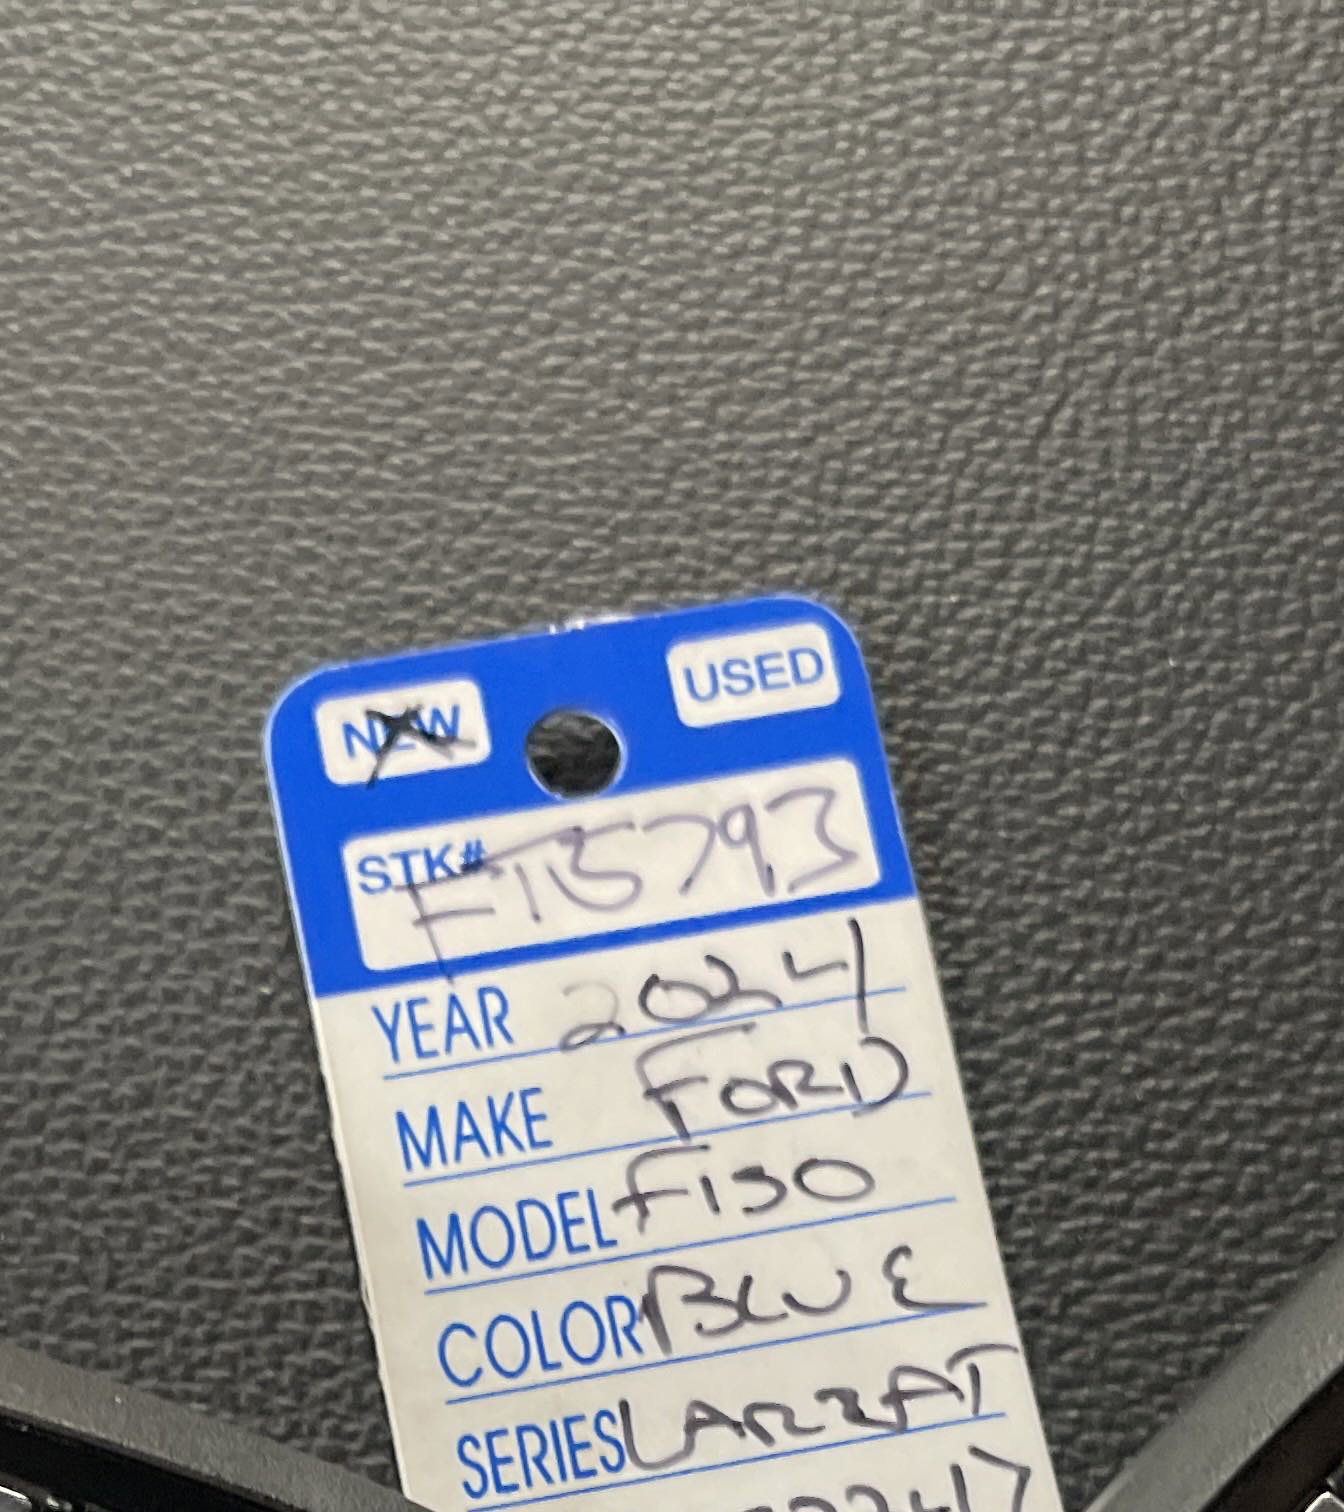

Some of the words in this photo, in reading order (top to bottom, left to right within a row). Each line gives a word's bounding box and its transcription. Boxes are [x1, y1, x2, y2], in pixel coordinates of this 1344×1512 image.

[682, 646, 824, 703] USED
[357, 837, 487, 896] STK#
[372, 986, 516, 1064] YEAR
[635, 1022, 909, 1142] FORD
[395, 1087, 553, 1172] MAKE
[613, 1142, 875, 1234] F150
[416, 1187, 618, 1281] MODEL
[437, 1294, 645, 1388] COLOR
[639, 1245, 989, 1355] BLUE
[457, 1409, 626, 1500] SERIES
